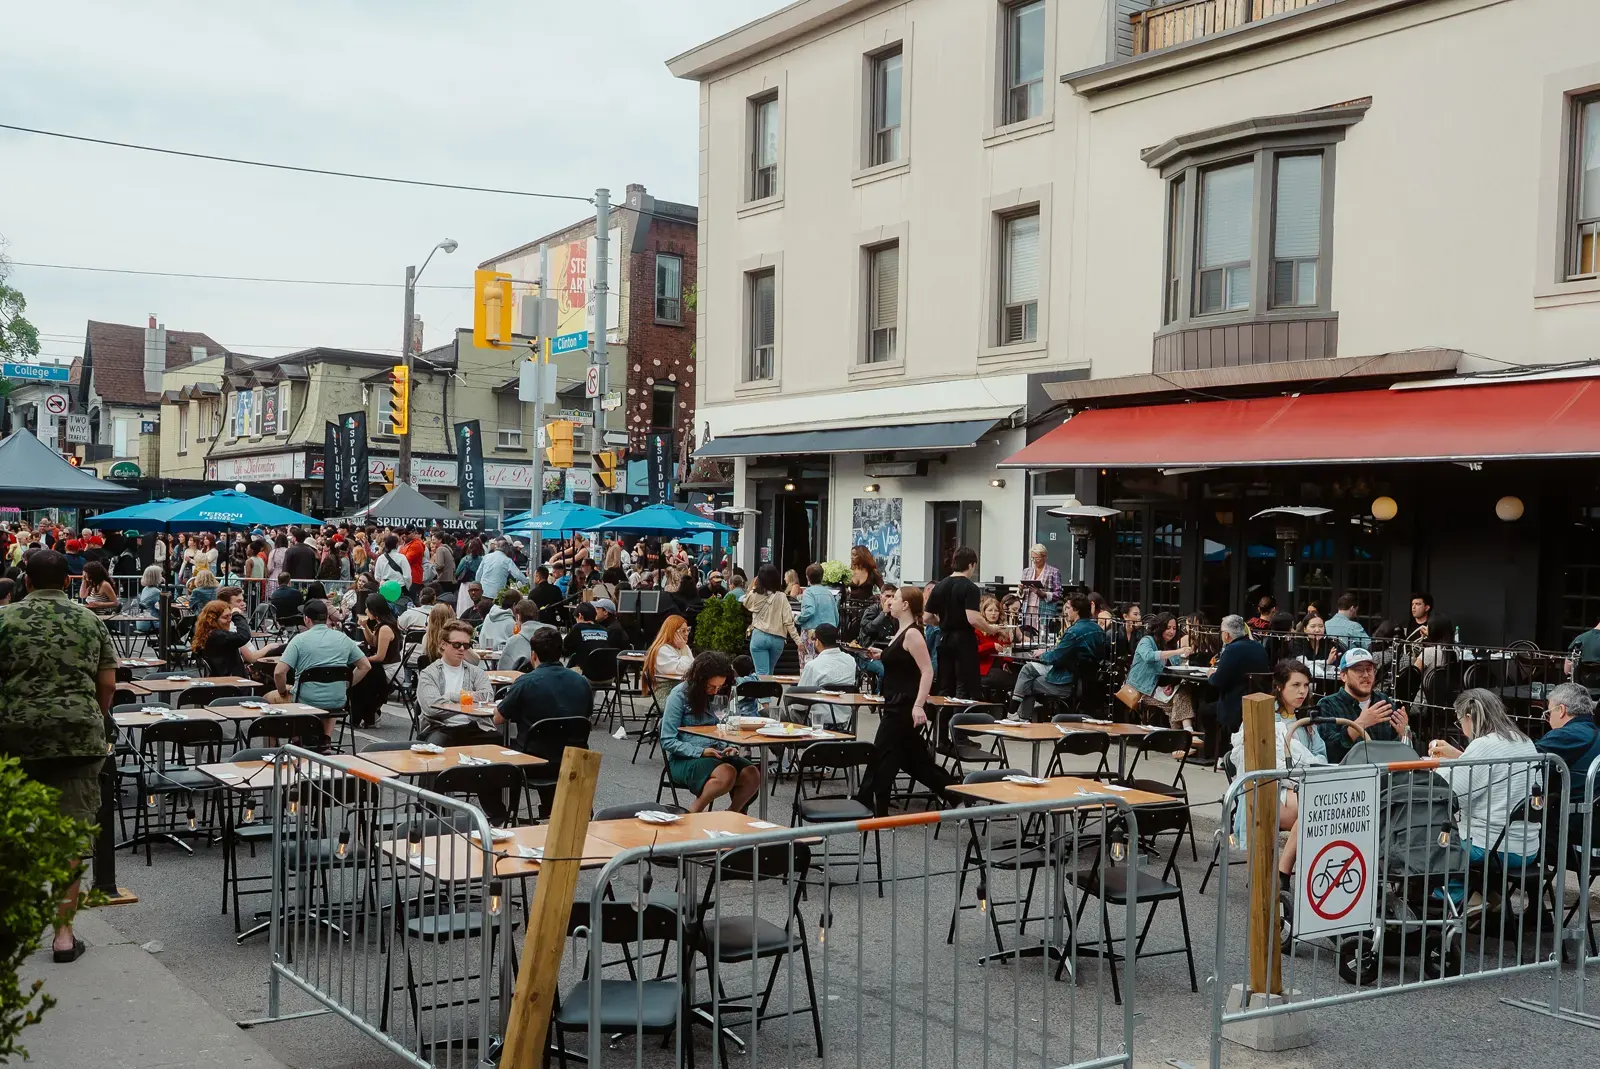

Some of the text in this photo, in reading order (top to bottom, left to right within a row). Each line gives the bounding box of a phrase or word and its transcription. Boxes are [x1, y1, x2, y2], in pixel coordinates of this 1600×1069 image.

[557, 336, 577, 350] Clinton
[14, 365, 50, 378] College
[70, 416, 86, 424] TWO
[69, 426, 86, 434] WAY
[350, 430, 358, 502] SPIDUCCI
[465, 438, 474, 508] SPIDUCCI
[376, 517, 426, 528] SPIDUCCI
[443, 520, 478, 530] SHACK
[882, 527, 900, 553] Voce
[1314, 790, 1366, 807] CYCLISTS AND
[1308, 804, 1370, 822] SKATEBOARDERS
[1306, 820, 1370, 838] MUST DISMOUNT
